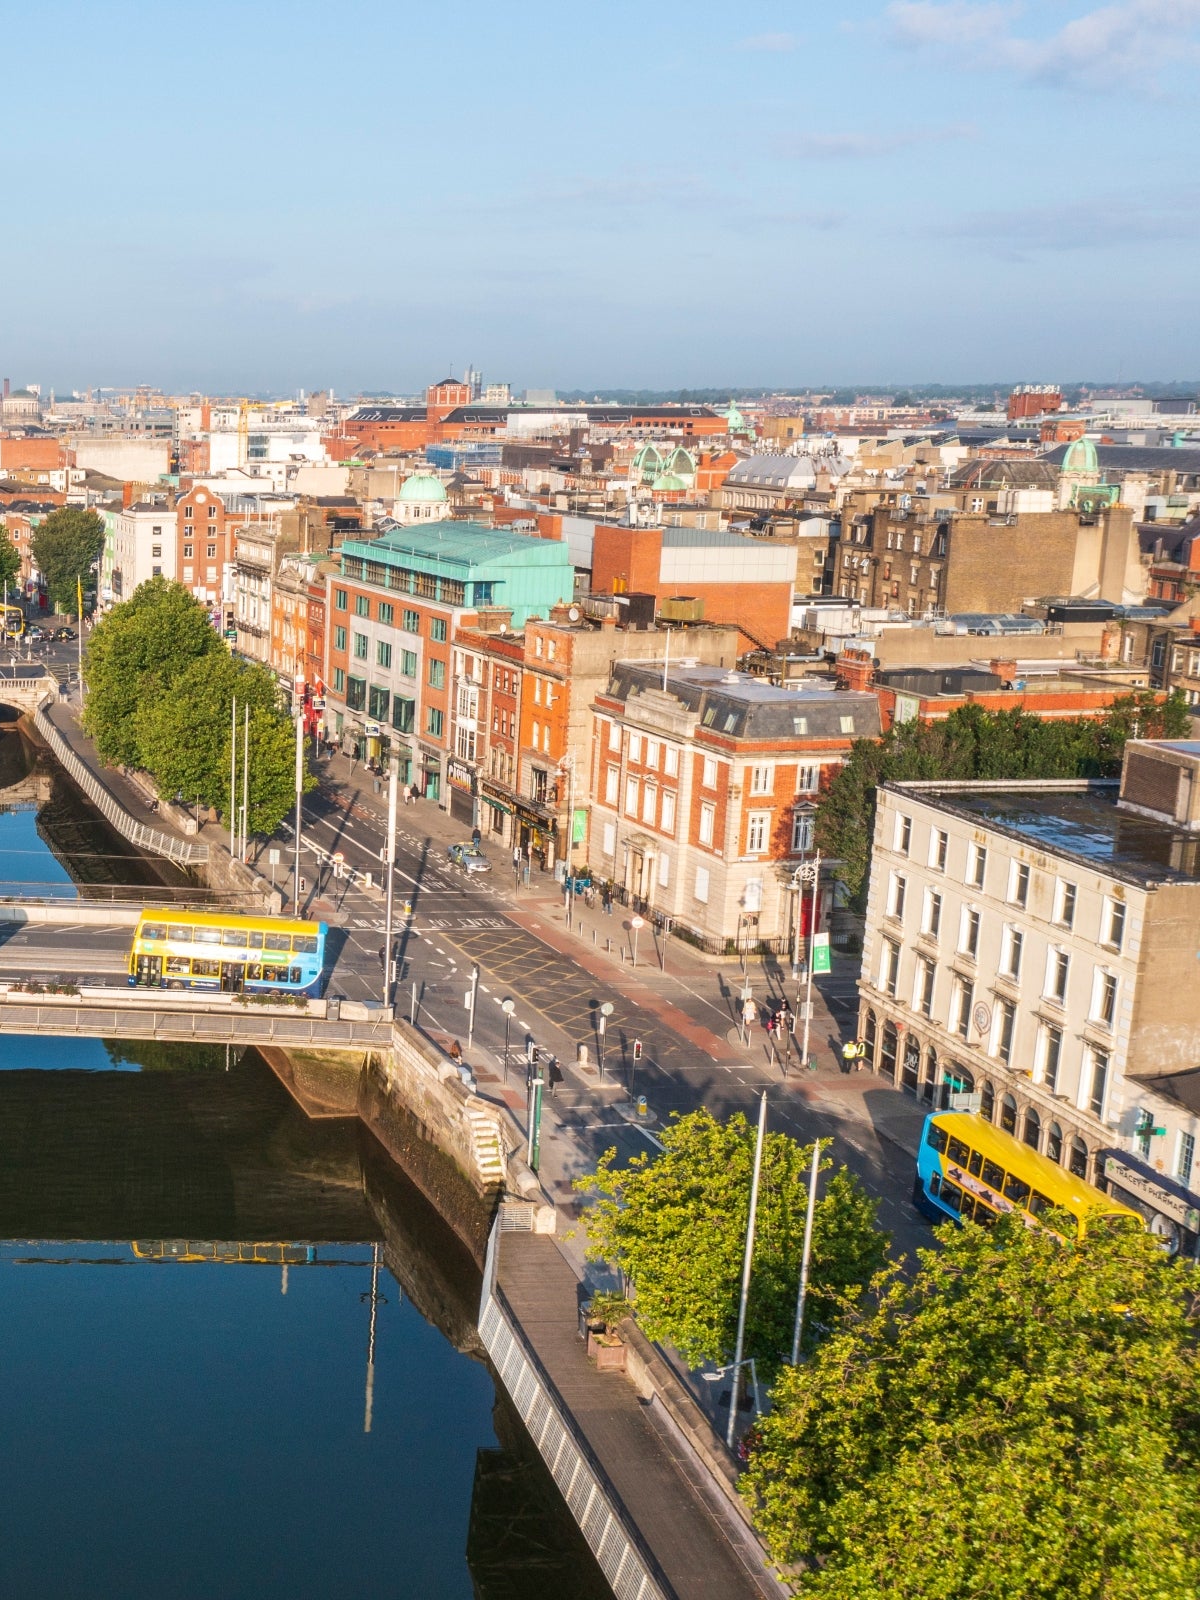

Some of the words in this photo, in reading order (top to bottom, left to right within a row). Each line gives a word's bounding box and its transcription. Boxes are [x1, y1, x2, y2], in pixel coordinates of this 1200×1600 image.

[428, 918, 452, 928] NO
[457, 918, 507, 928] ENTRY
[1148, 1187, 1188, 1215] PHARMACY
